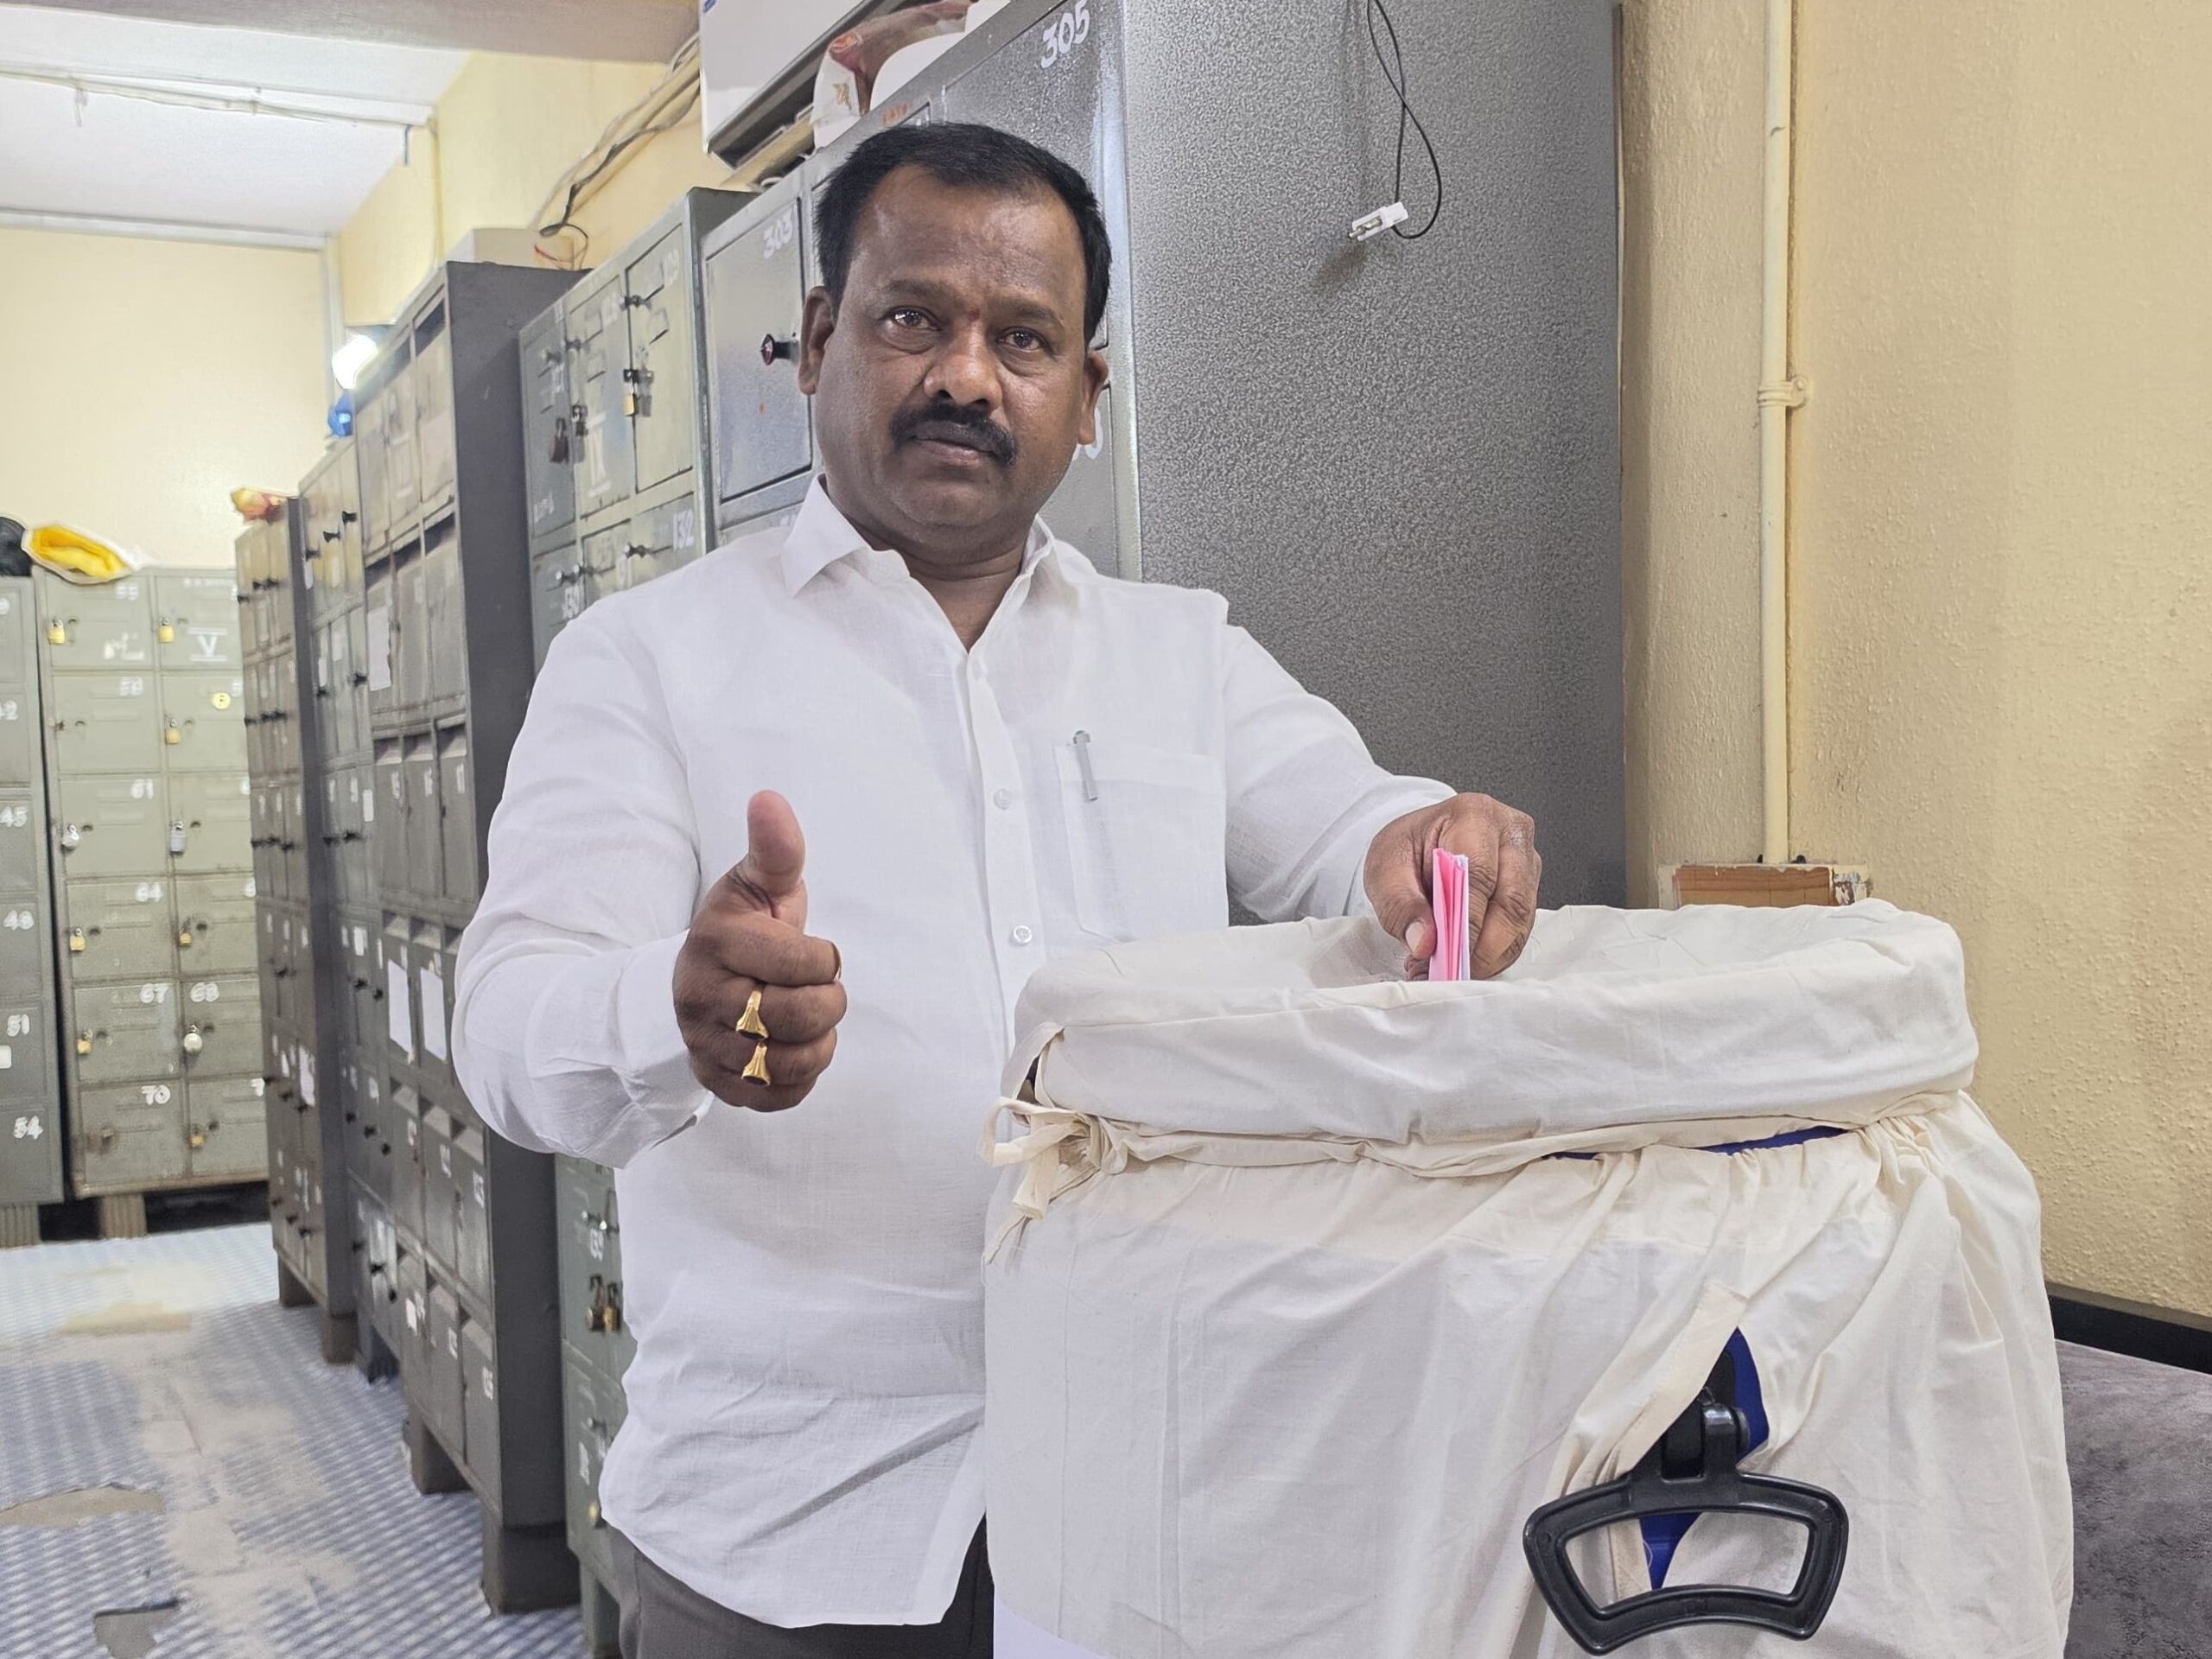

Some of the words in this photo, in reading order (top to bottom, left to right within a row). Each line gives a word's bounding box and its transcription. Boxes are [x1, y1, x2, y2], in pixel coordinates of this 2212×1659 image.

[1039, 0, 1090, 69] 305
[764, 209, 793, 259] 303
[0, 699, 18, 721] 2
[0, 805, 28, 827] 45
[139, 982, 170, 1004] 67
[141, 1084, 172, 1106] 70
